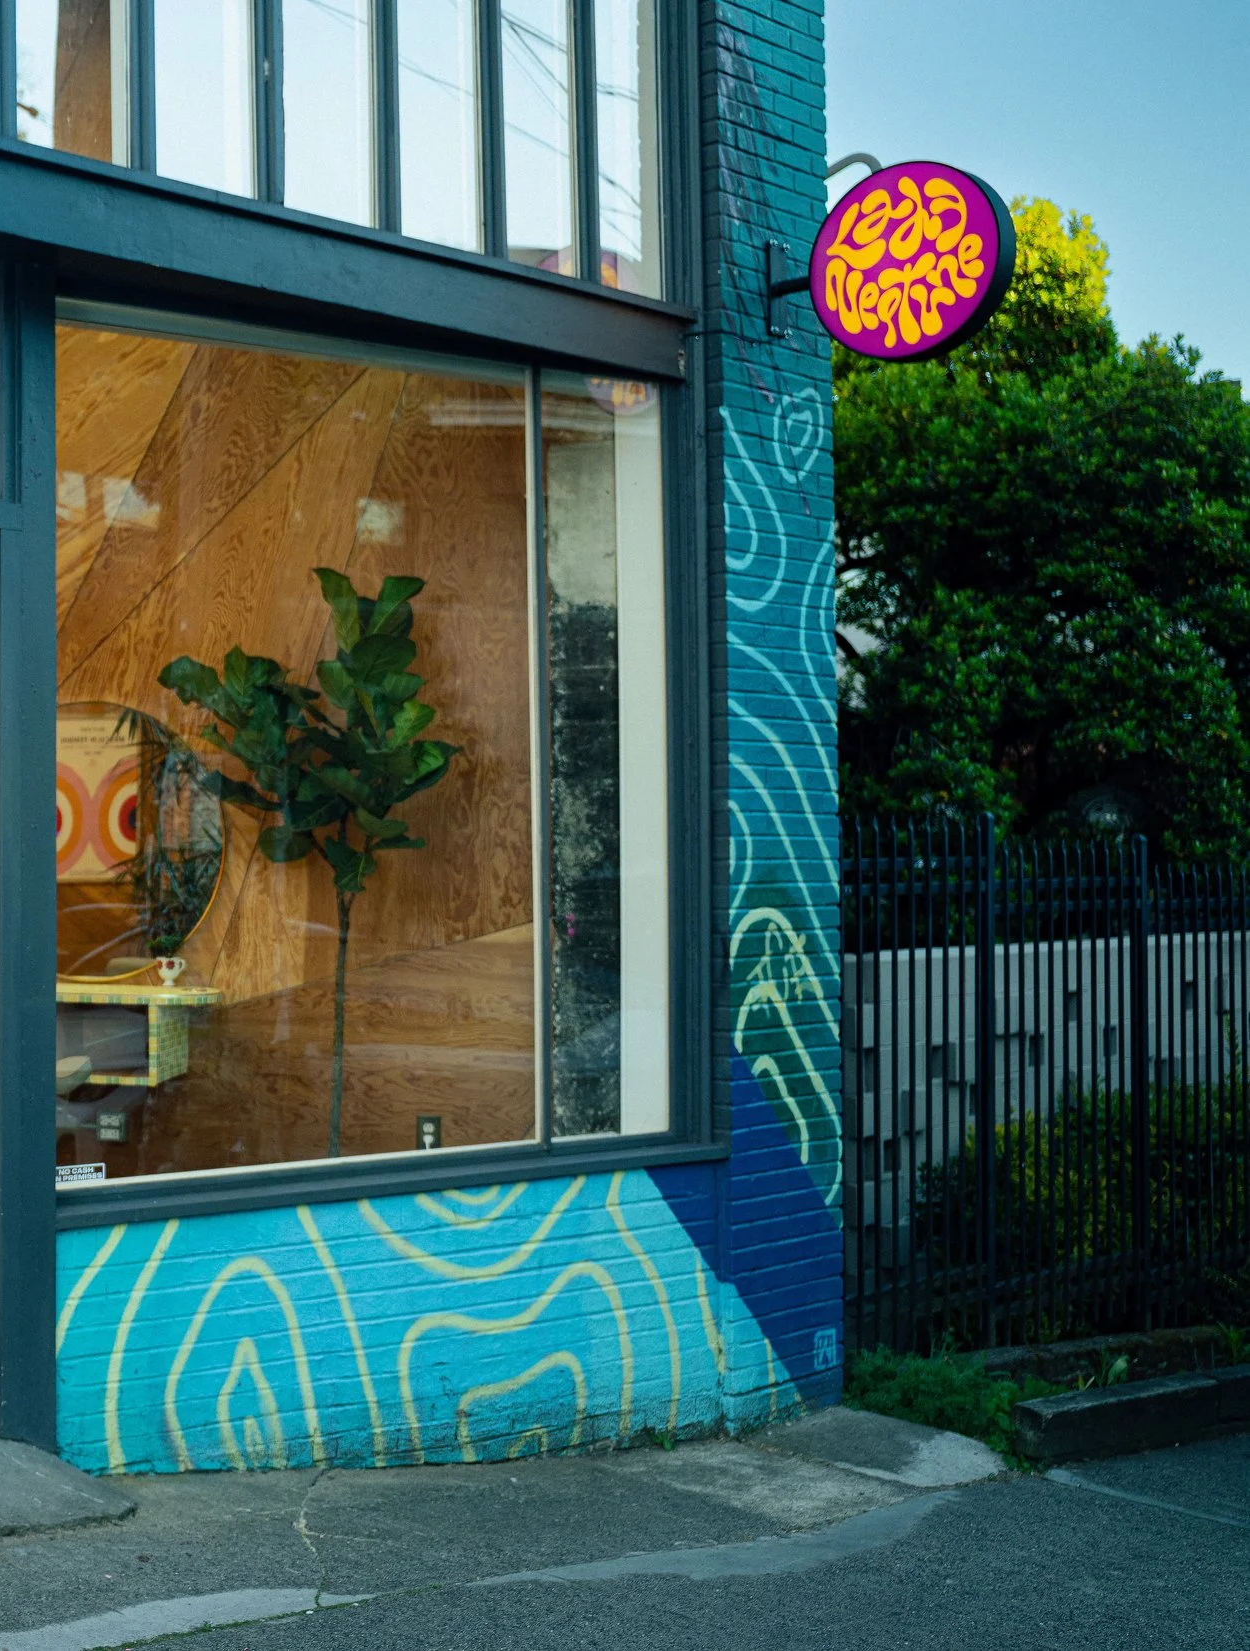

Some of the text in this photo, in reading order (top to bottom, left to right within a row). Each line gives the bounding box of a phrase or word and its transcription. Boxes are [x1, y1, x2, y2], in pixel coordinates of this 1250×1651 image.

[825, 233, 984, 348] Neptune
[71, 1166, 94, 1174] CASH
[63, 1172, 102, 1181] PREMISES
